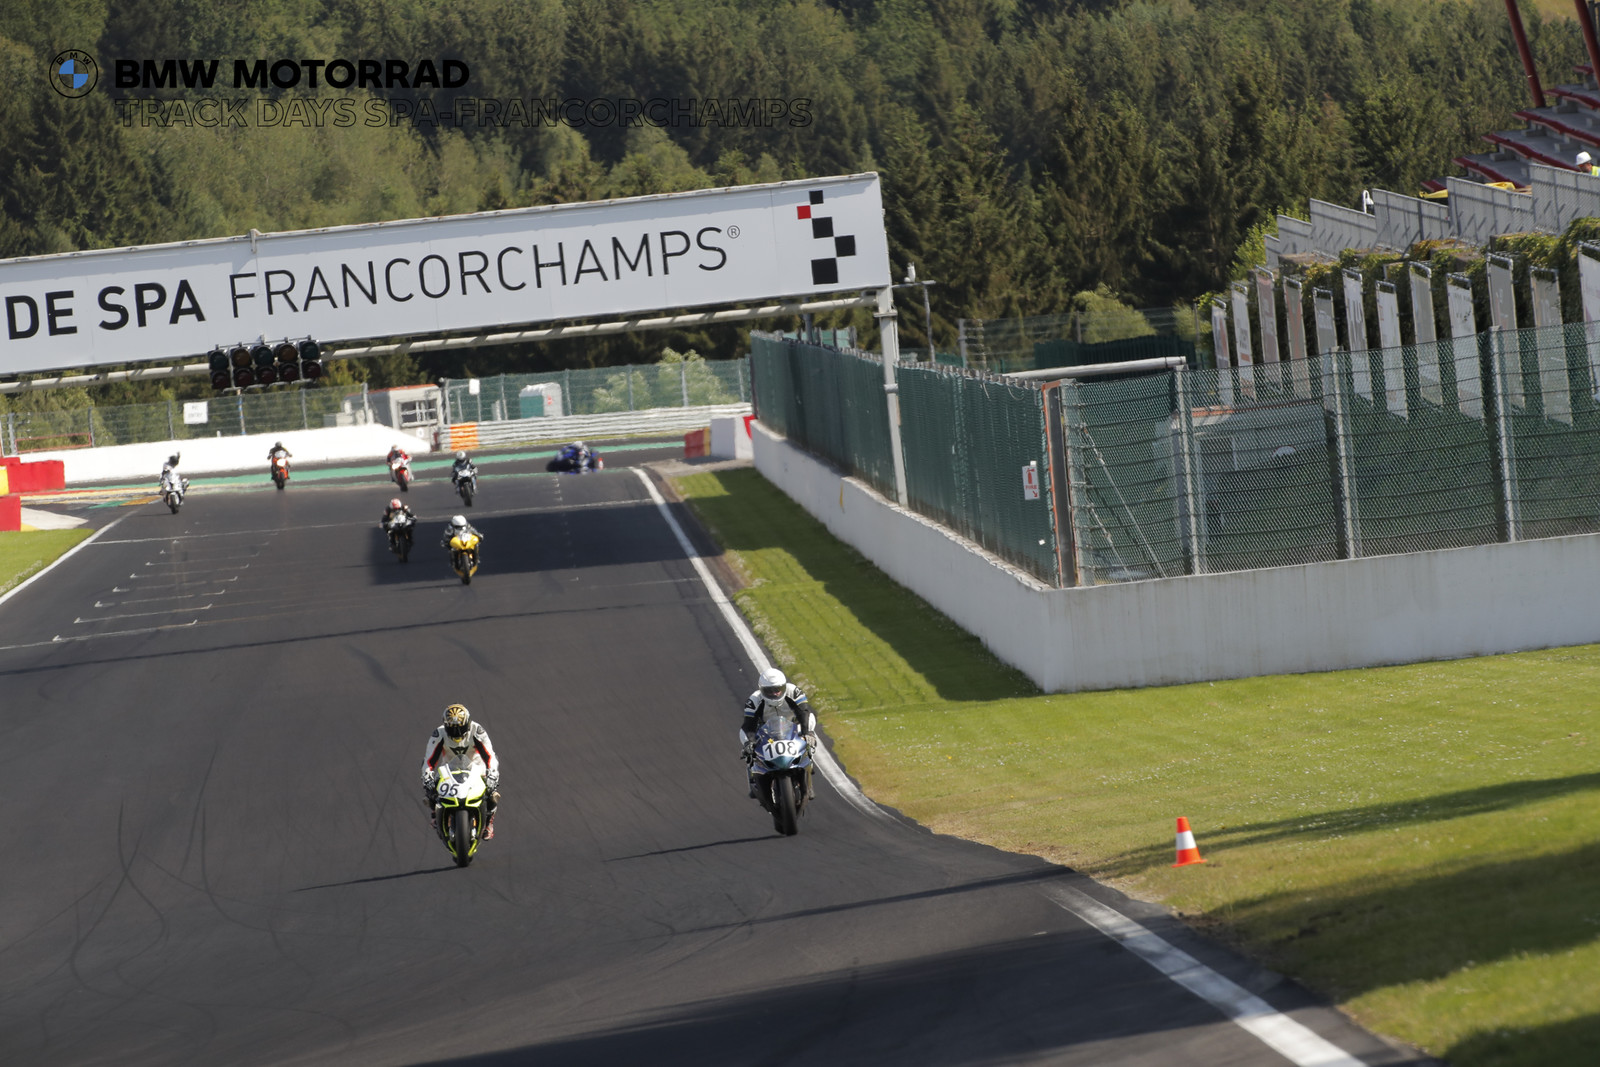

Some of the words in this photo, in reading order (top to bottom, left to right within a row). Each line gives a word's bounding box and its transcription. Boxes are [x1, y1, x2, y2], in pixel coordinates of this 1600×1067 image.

[5, 290, 77, 340] DE
[98, 279, 206, 330] SPA
[440, 783, 459, 797] 95
